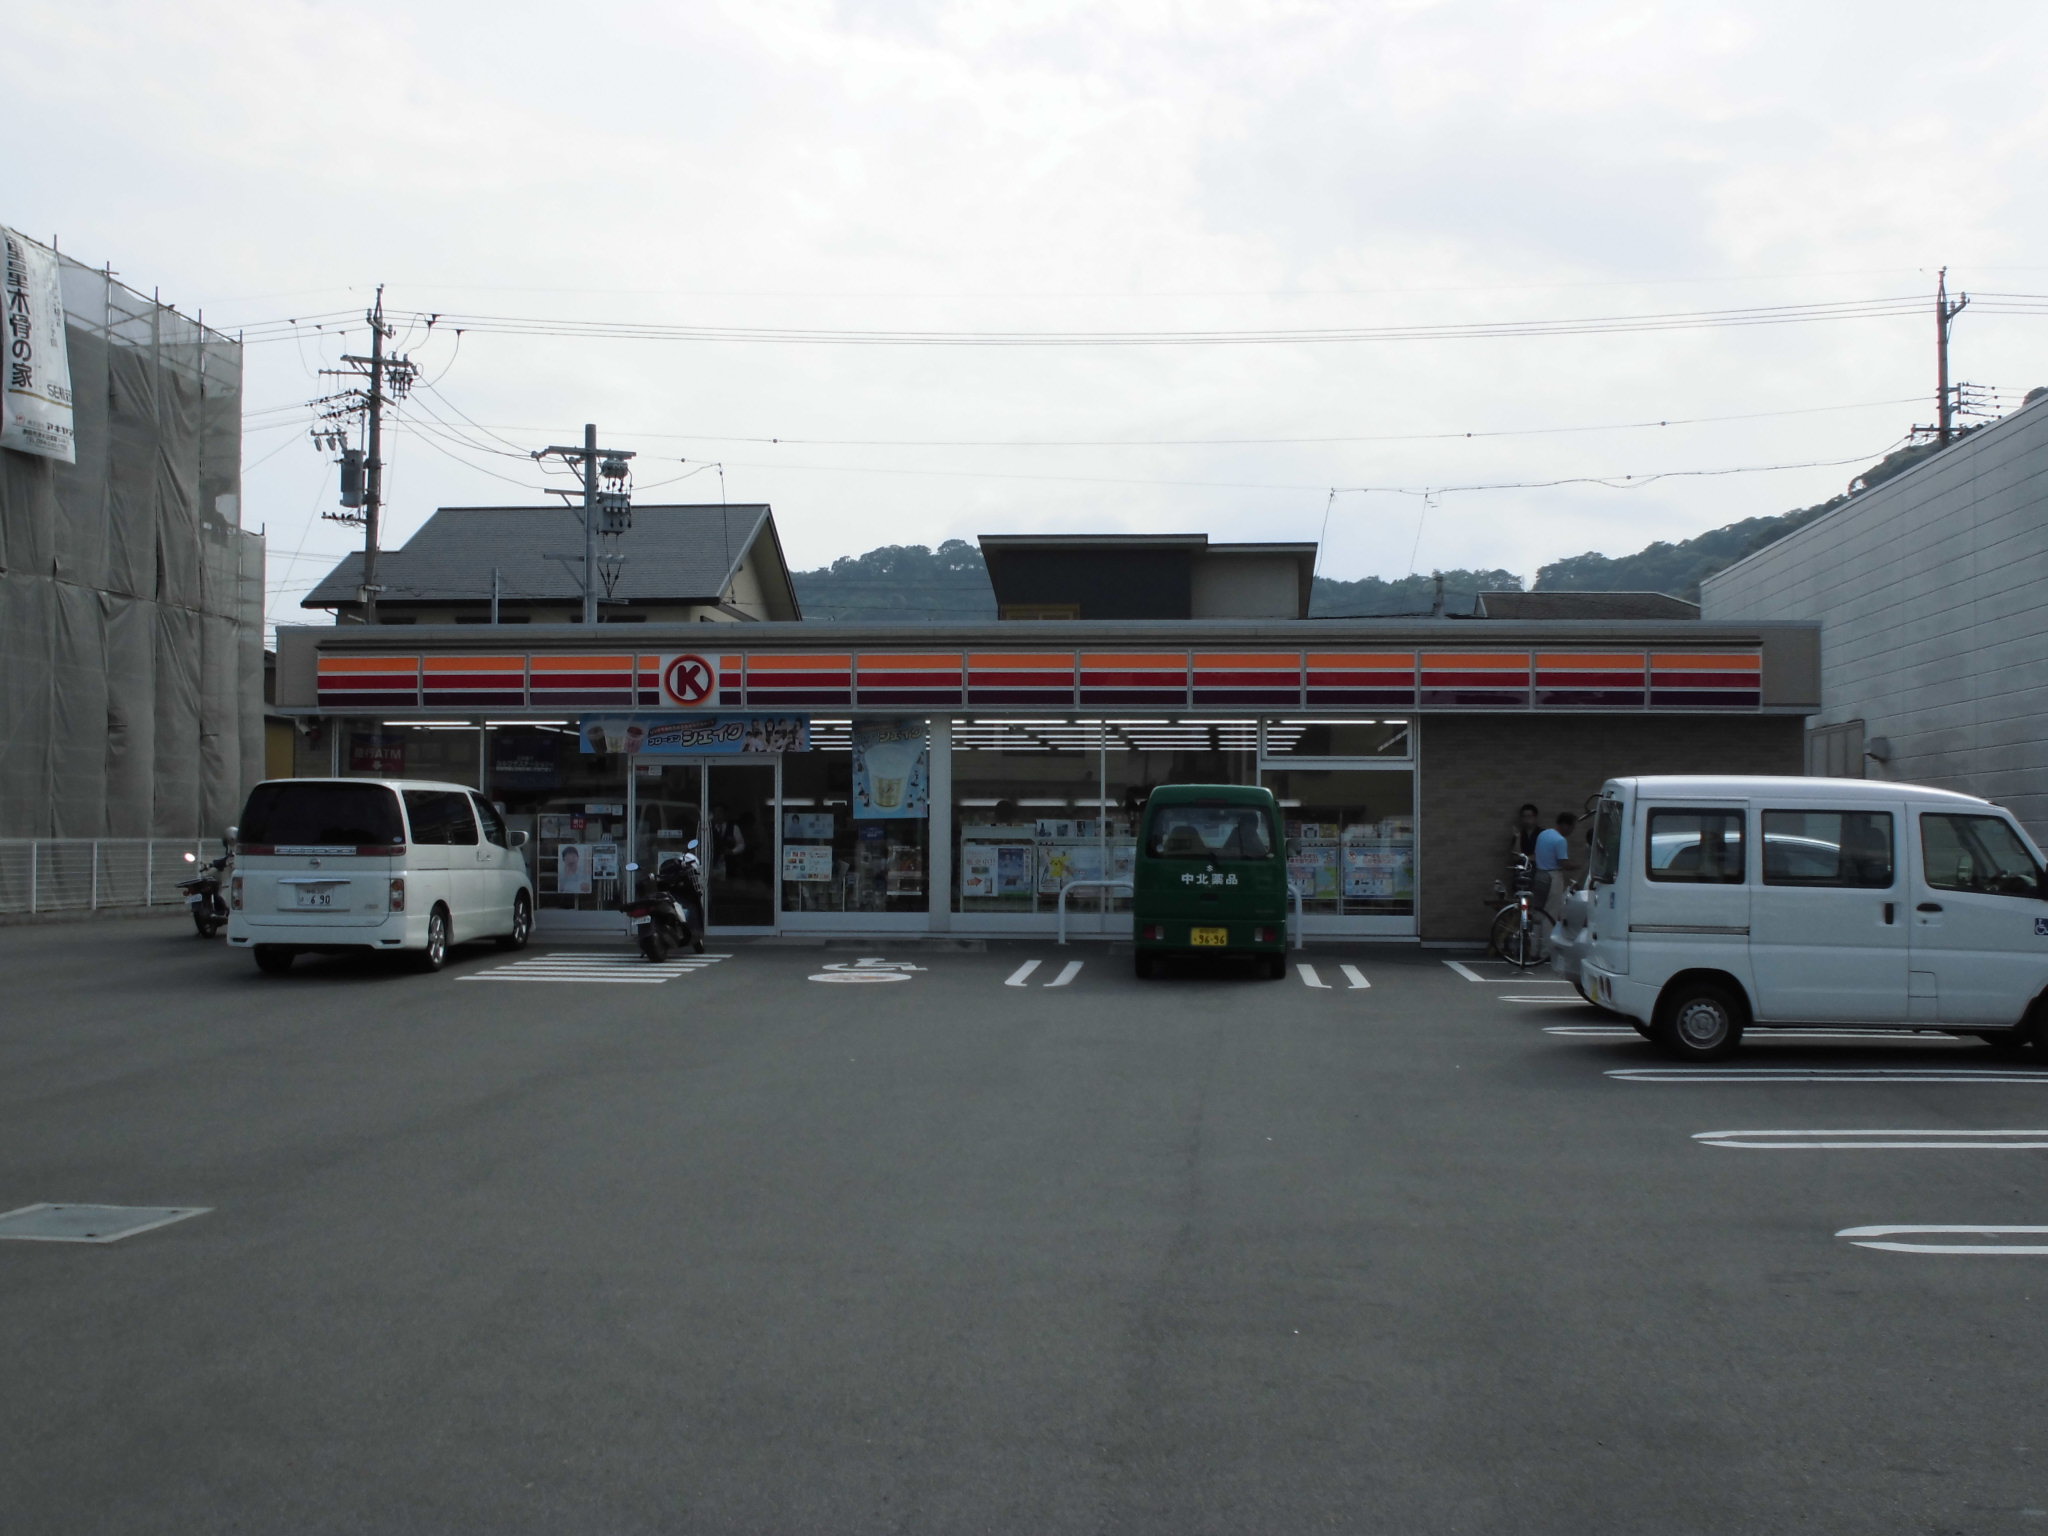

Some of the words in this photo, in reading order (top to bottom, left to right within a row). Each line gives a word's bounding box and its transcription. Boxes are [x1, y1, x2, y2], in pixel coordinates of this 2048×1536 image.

[678, 665, 705, 698] K
[1181, 873, 1238, 885] 中北薬品
